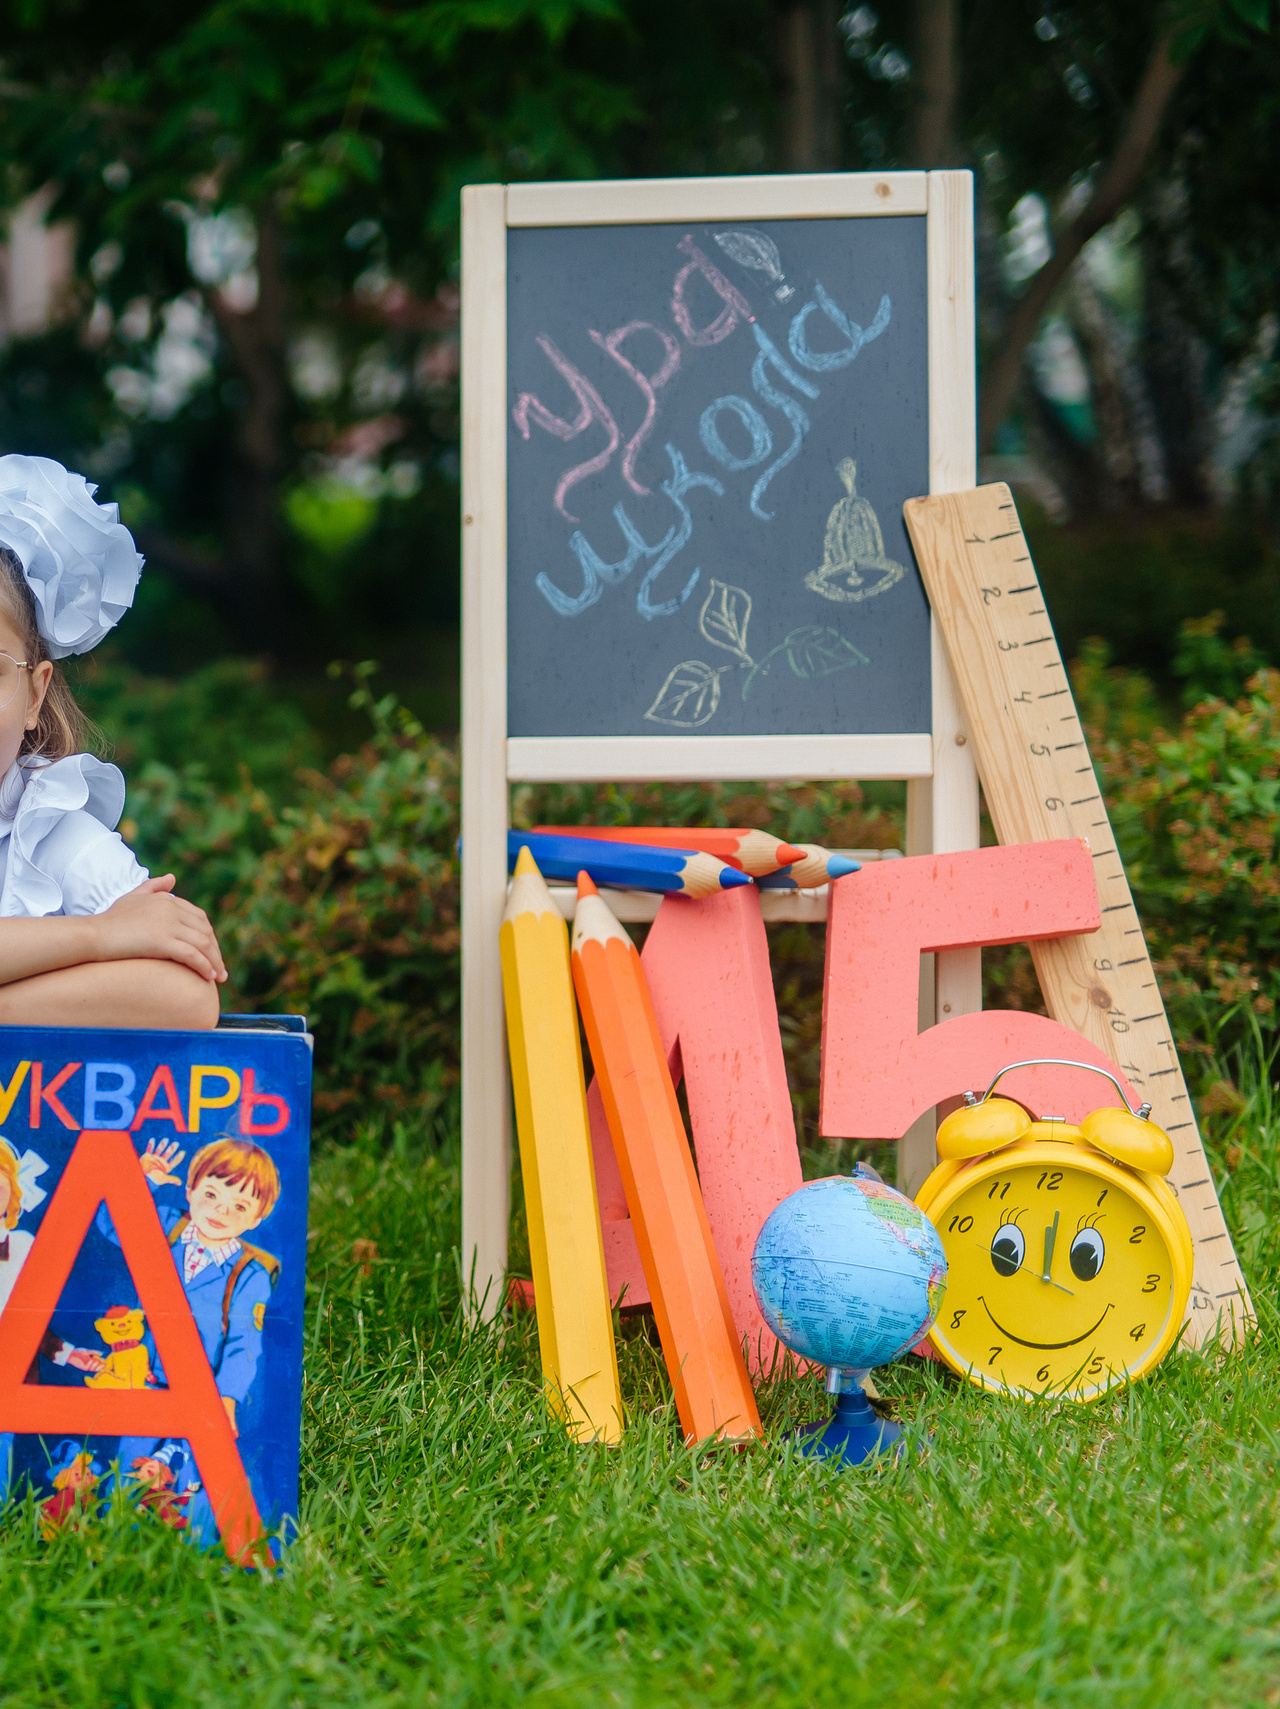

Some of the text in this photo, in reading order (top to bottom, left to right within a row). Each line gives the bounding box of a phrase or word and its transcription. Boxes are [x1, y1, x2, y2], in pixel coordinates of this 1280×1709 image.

[965, 532, 985, 545] 1
[981, 587, 1001, 605] 2
[998, 639, 1019, 652] 3
[1014, 691, 1032, 703] 4
[1030, 743, 1051, 758] 5
[1045, 797, 1065, 812] 6
[1094, 958, 1113, 972] 9
[1107, 1007, 1130, 1033] 10
[1036, 1172, 1064, 1191] 12
[988, 1182, 1011, 1200] 11
[1096, 1189, 1108, 1207] 1
[948, 1215, 974, 1234] 10
[1128, 1226, 1146, 1244] 2
[1141, 1274, 1161, 1293] 3
[950, 1310, 967, 1329] 8
[1129, 1323, 1147, 1342] 4
[988, 1347, 1003, 1366] 7
[1087, 1356, 1105, 1375] 5
[1036, 1364, 1051, 1382] 6
